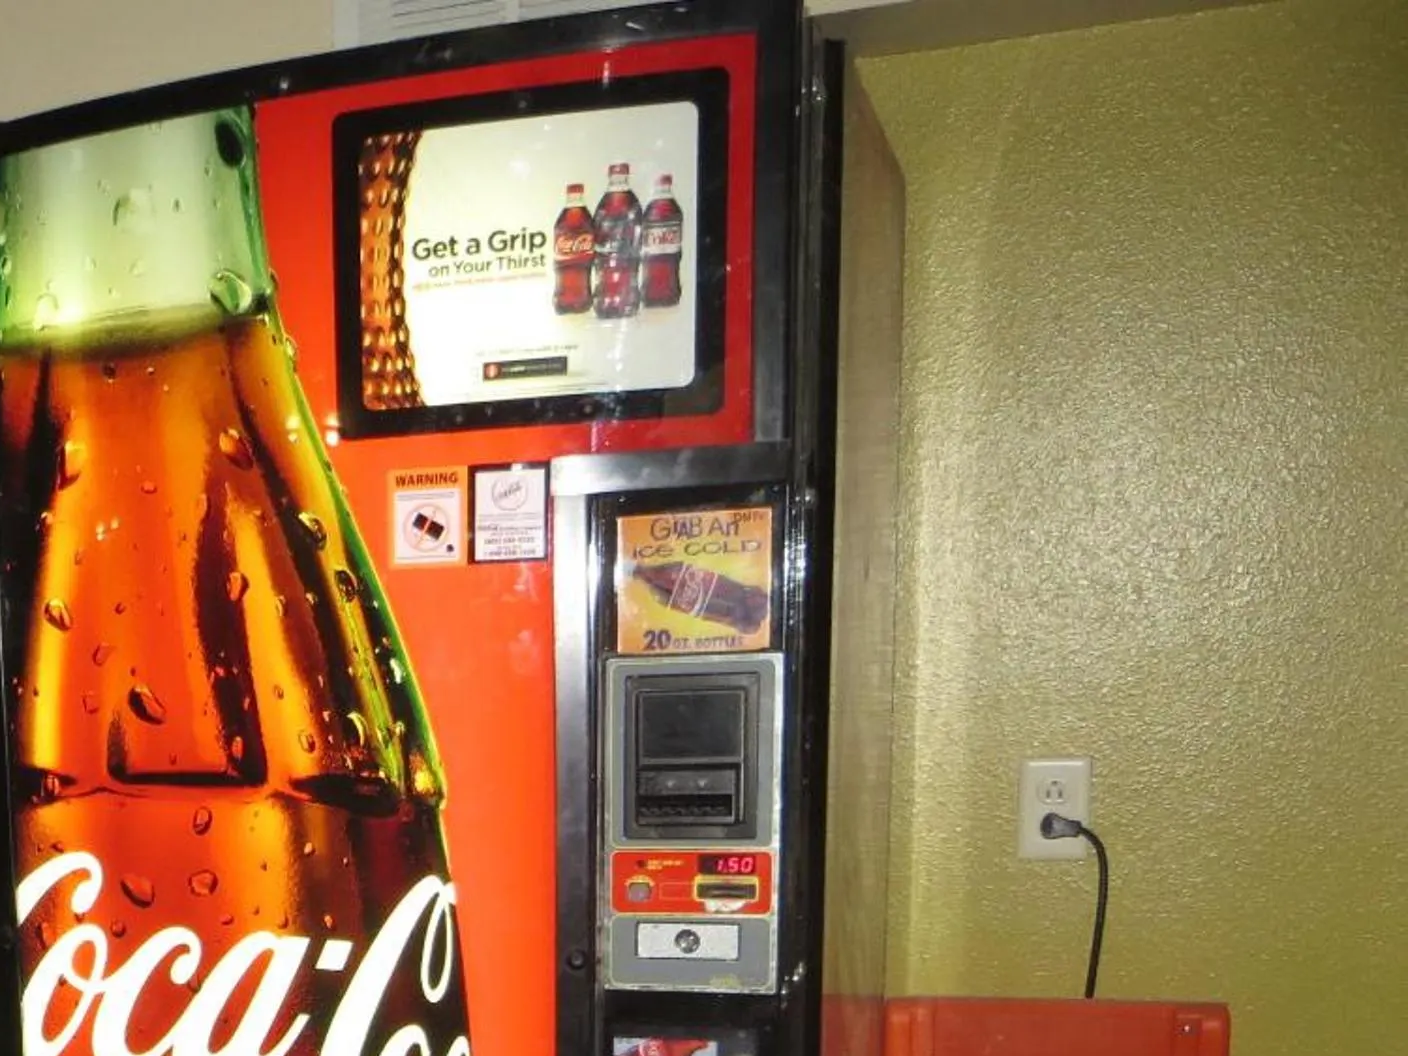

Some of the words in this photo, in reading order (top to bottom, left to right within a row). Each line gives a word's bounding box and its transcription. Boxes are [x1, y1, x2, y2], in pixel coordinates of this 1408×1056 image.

[412, 235, 459, 261] Get
[465, 237, 481, 255] a
[487, 227, 547, 252] Grip
[428, 264, 450, 278] on
[452, 258, 492, 275] Your
[498, 253, 546, 270] Thirst
[395, 471, 459, 488] WARNING
[684, 539, 761, 557] COLD
[643, 629, 672, 651] 20
[716, 856, 754, 874] 1.50
